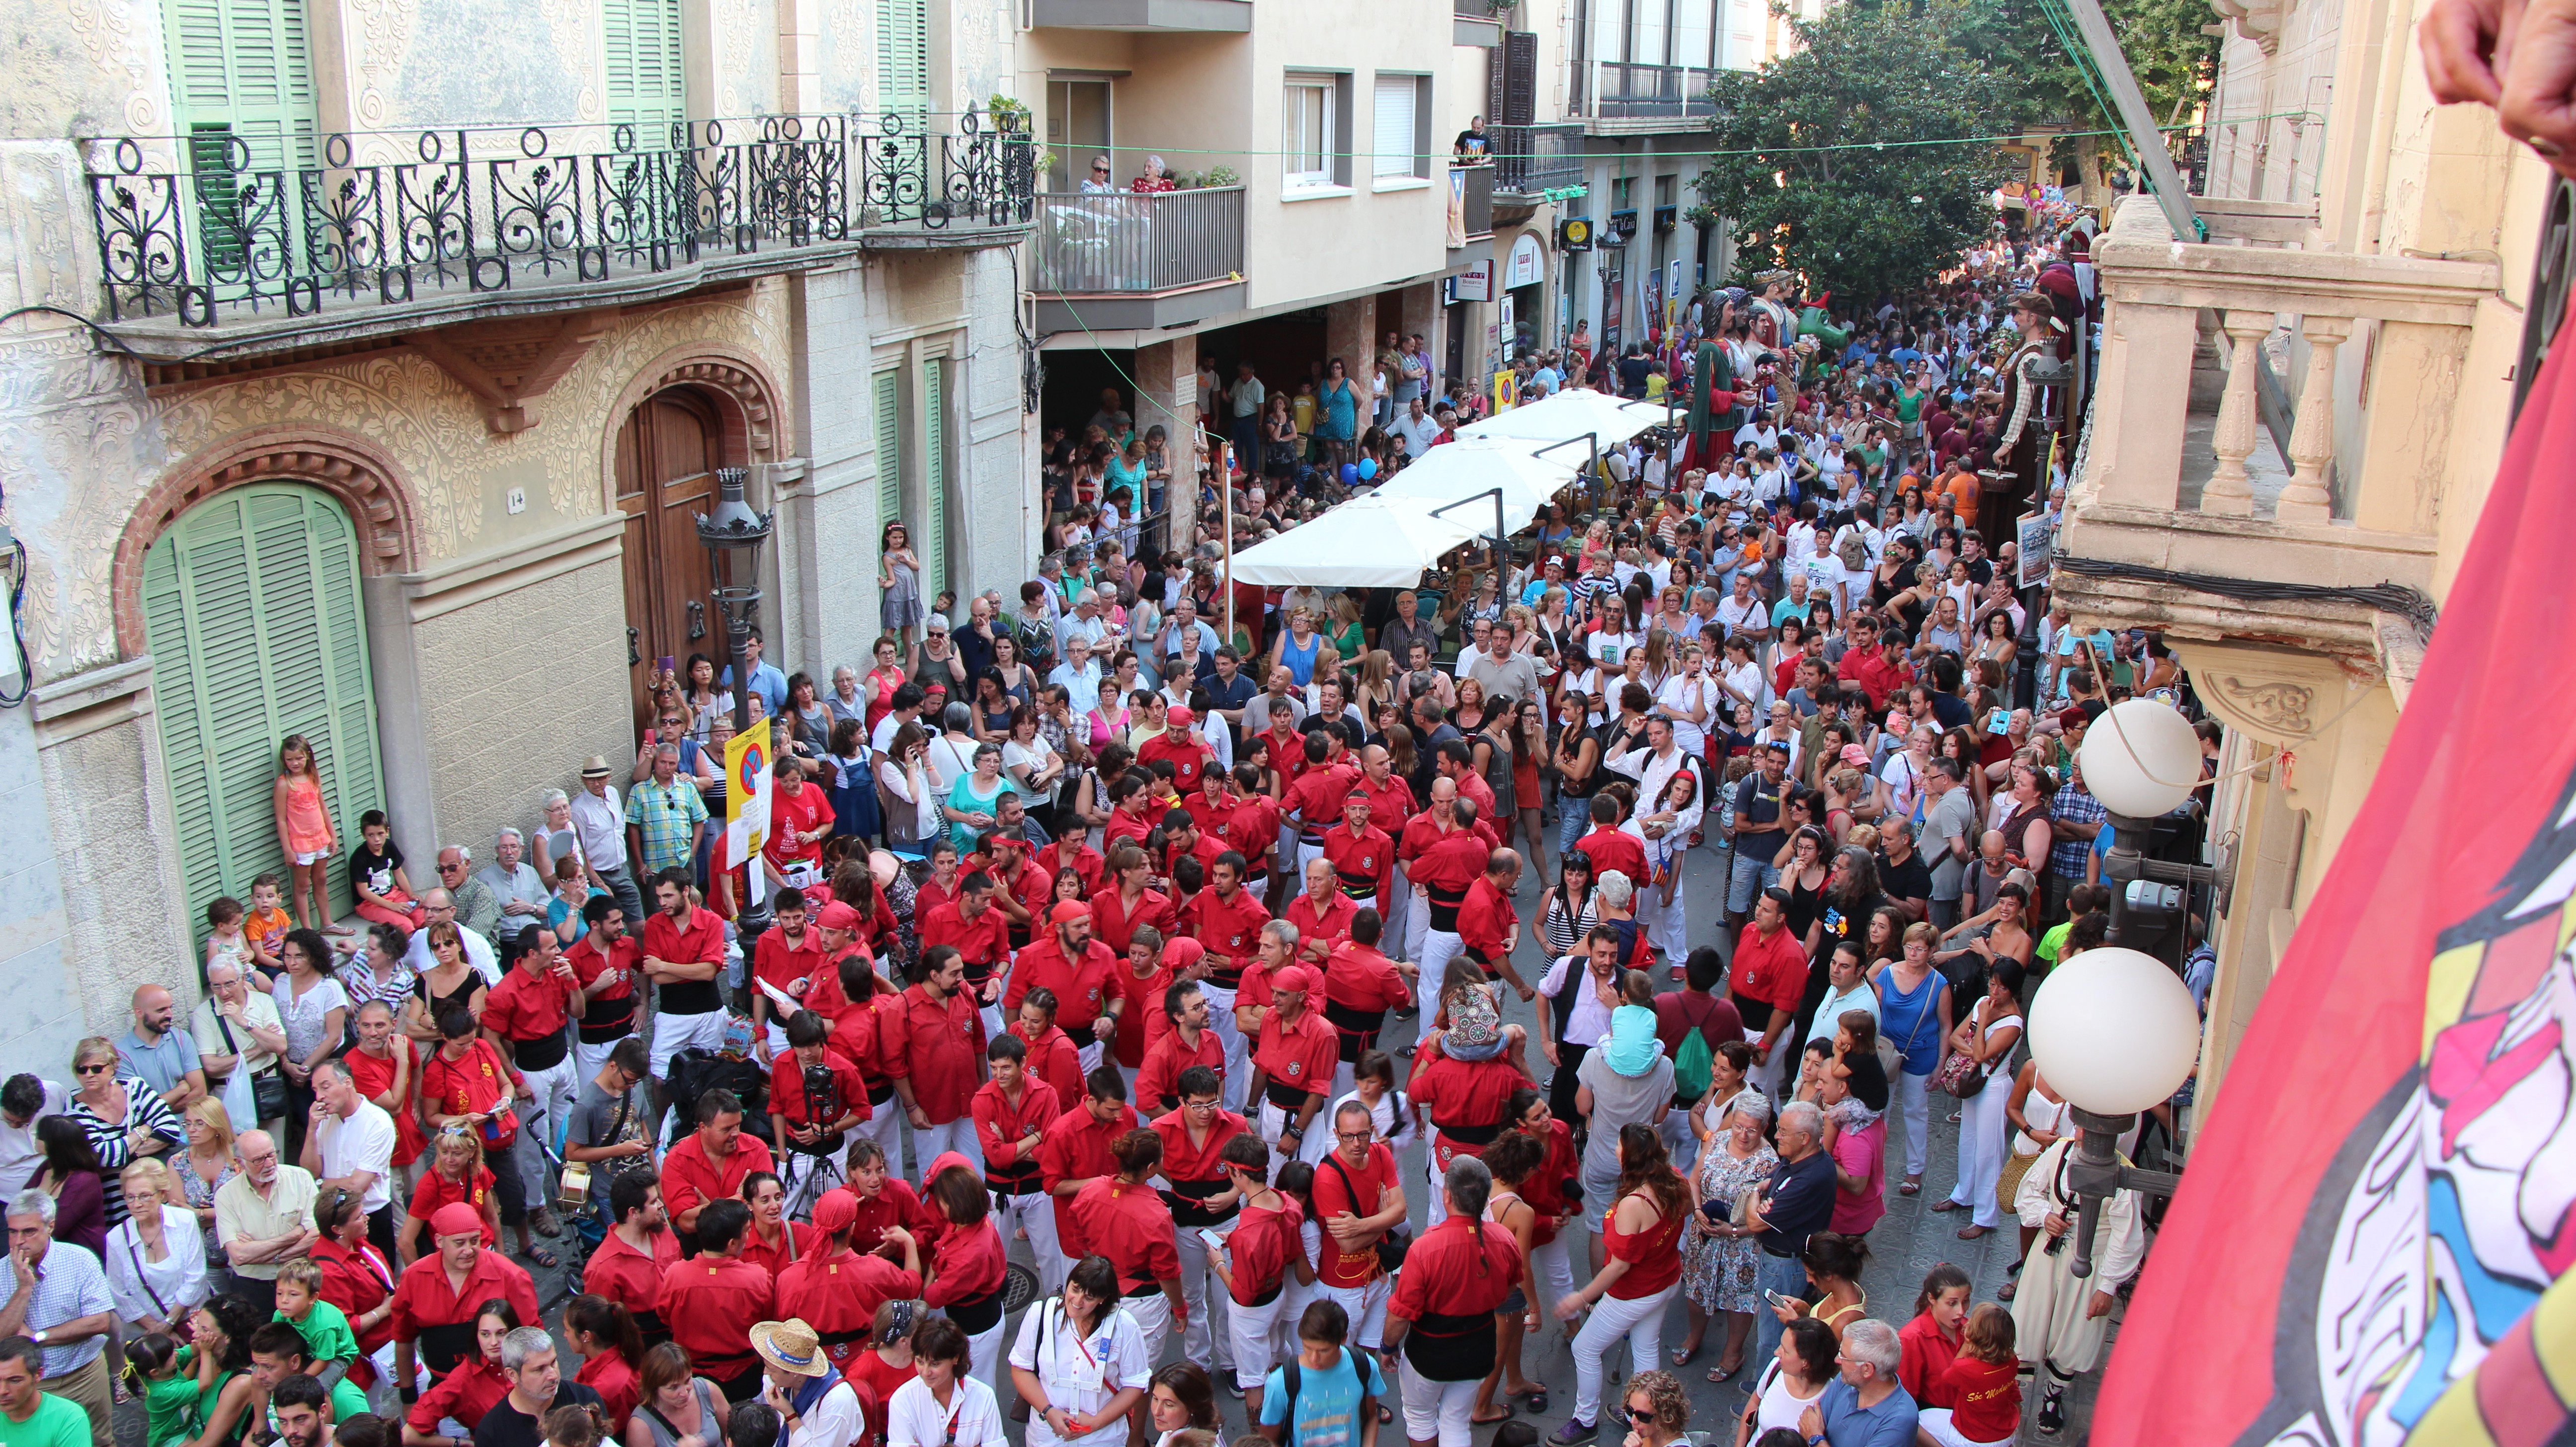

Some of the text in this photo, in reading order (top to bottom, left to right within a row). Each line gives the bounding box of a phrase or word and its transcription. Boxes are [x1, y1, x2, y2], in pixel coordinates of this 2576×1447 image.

[1518, 254, 1530, 263] over
[512, 493, 523, 506] 14
[730, 736, 752, 753] Senyalització
[1967, 1392, 1982, 1402] Sóc
